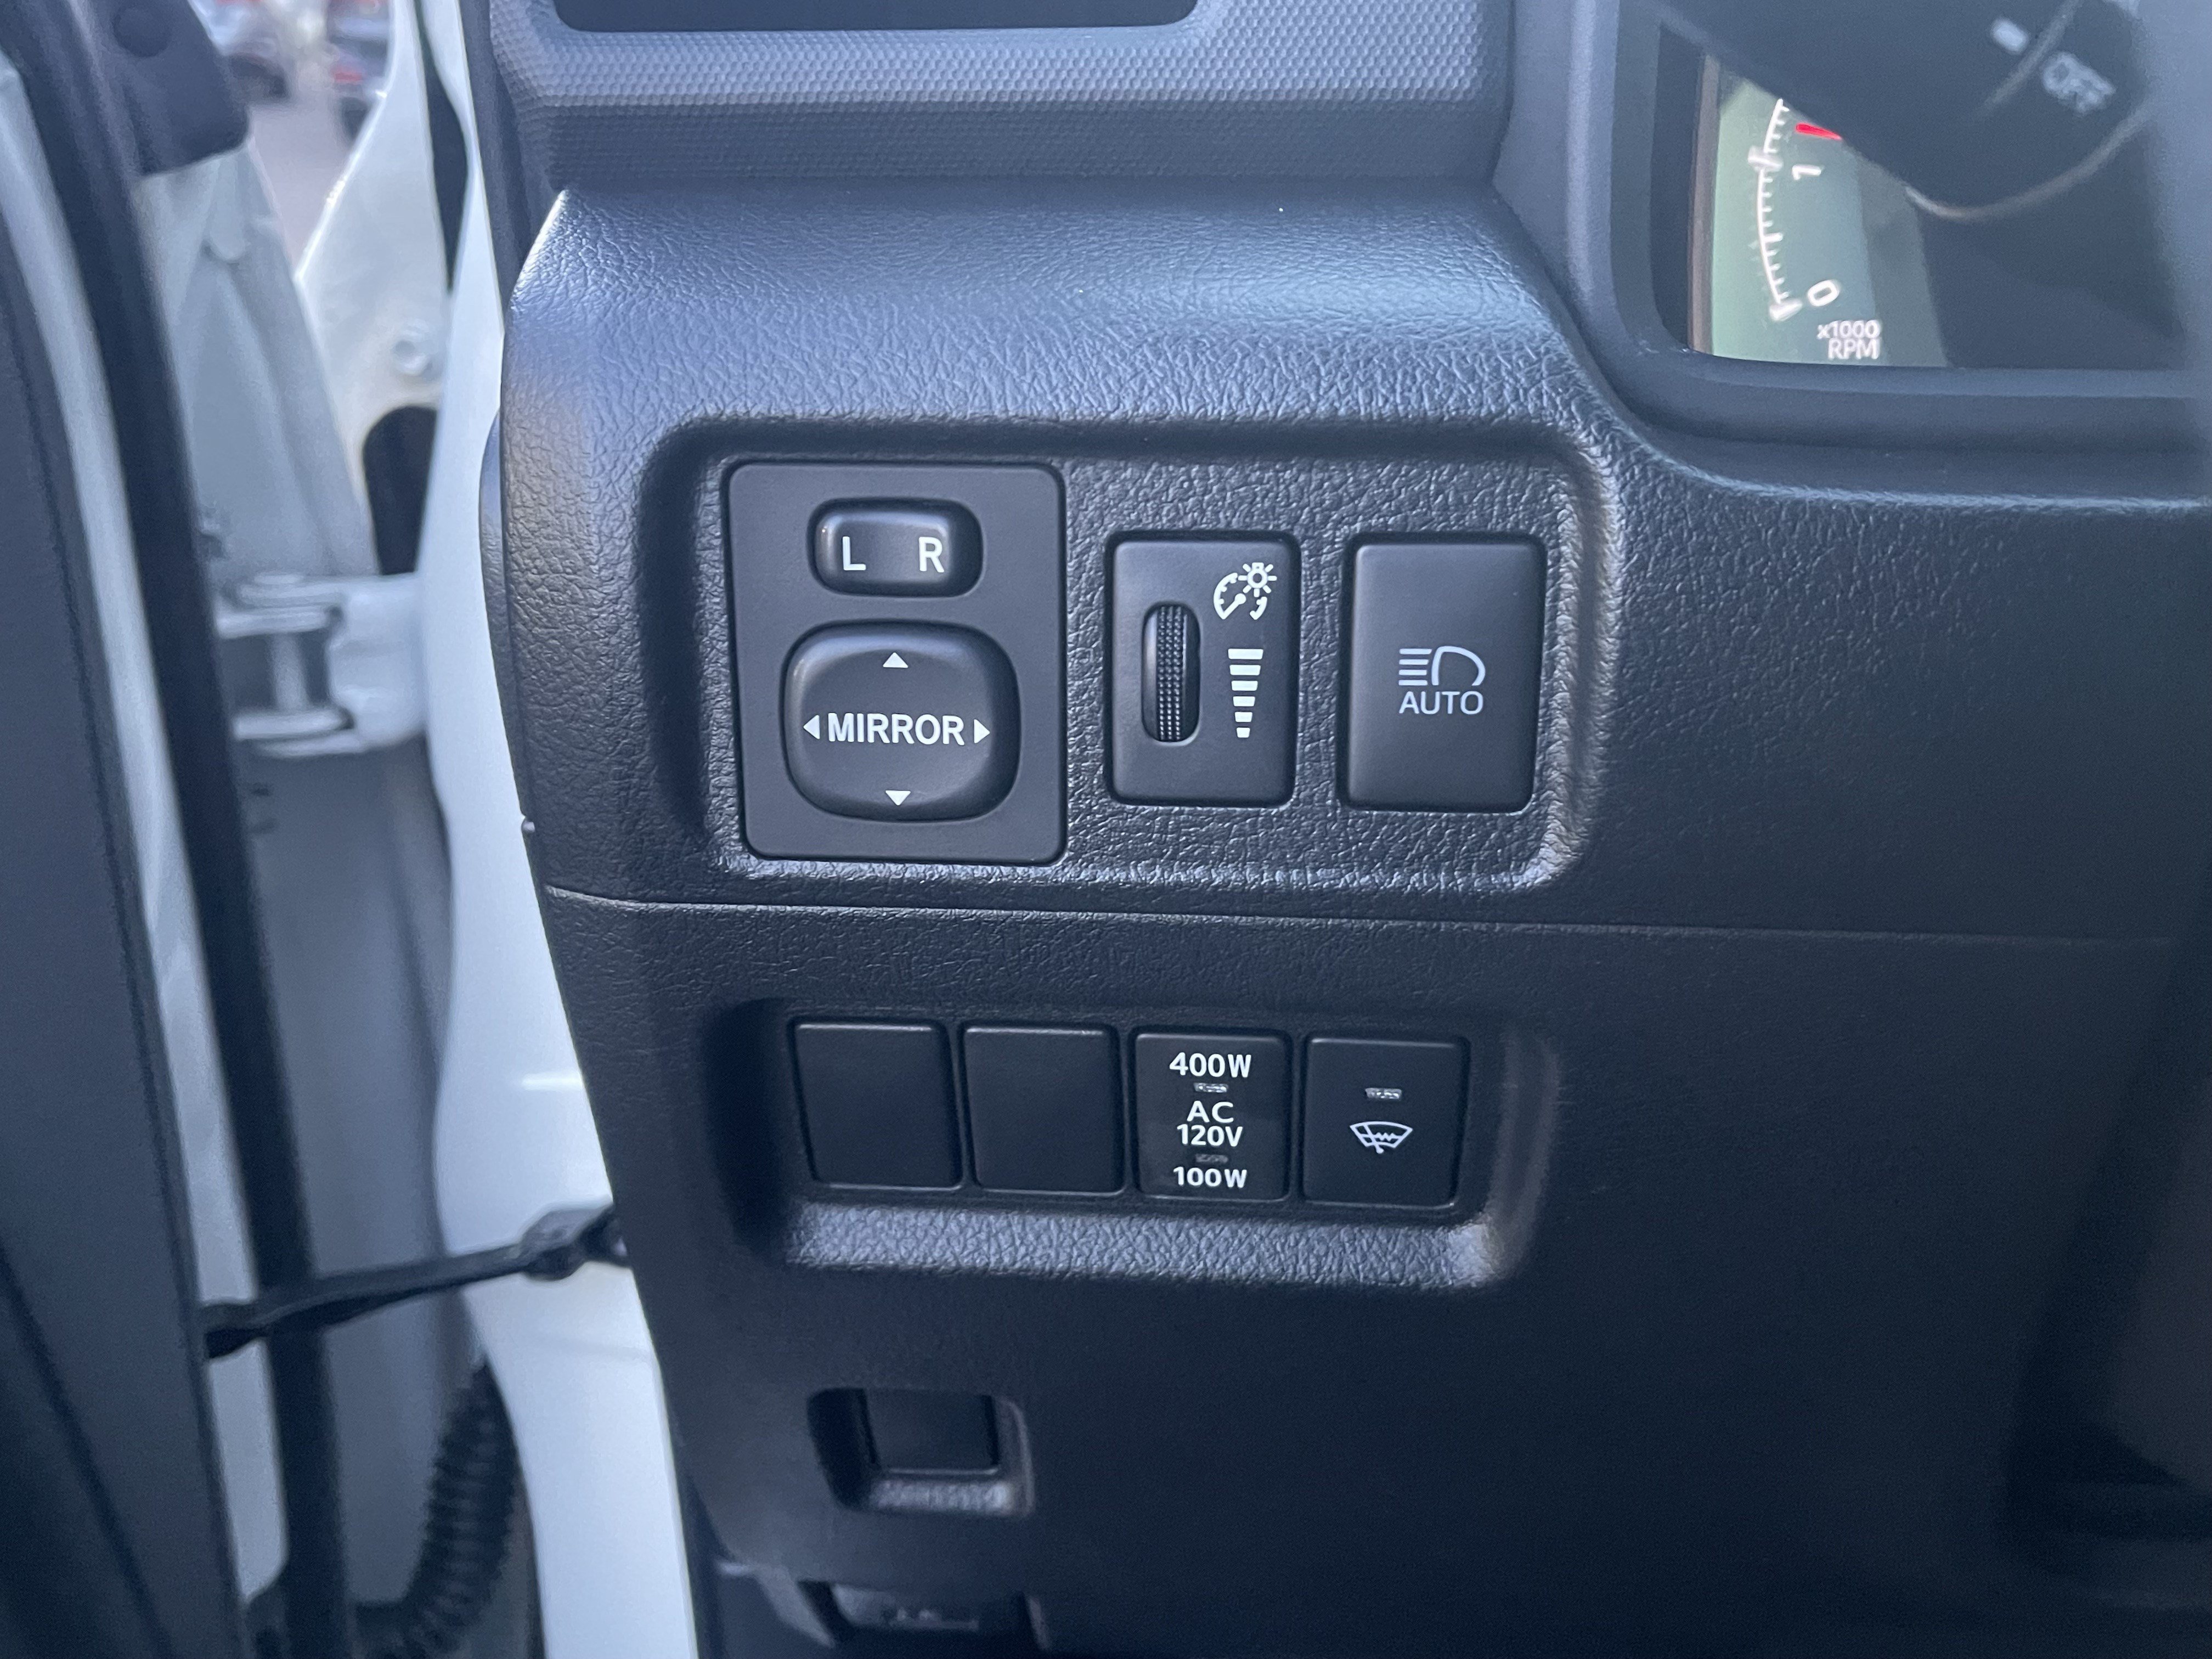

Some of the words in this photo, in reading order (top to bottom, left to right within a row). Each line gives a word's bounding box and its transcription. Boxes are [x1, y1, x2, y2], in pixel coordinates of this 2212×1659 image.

[1792, 165, 1821, 180] 1
[1807, 280, 1840, 307] 0
[1816, 320, 1881, 339] x1000
[1827, 337, 1881, 359] RPM
[842, 536, 866, 571] L
[918, 536, 945, 573] R
[1398, 691, 1484, 715] AUTO
[827, 713, 965, 746] MIRROR
[1169, 1052, 1251, 1078] 400W
[1186, 1101, 1234, 1123] AC
[1177, 1125, 1243, 1147] 120V
[1173, 1166, 1247, 1188] 100W
